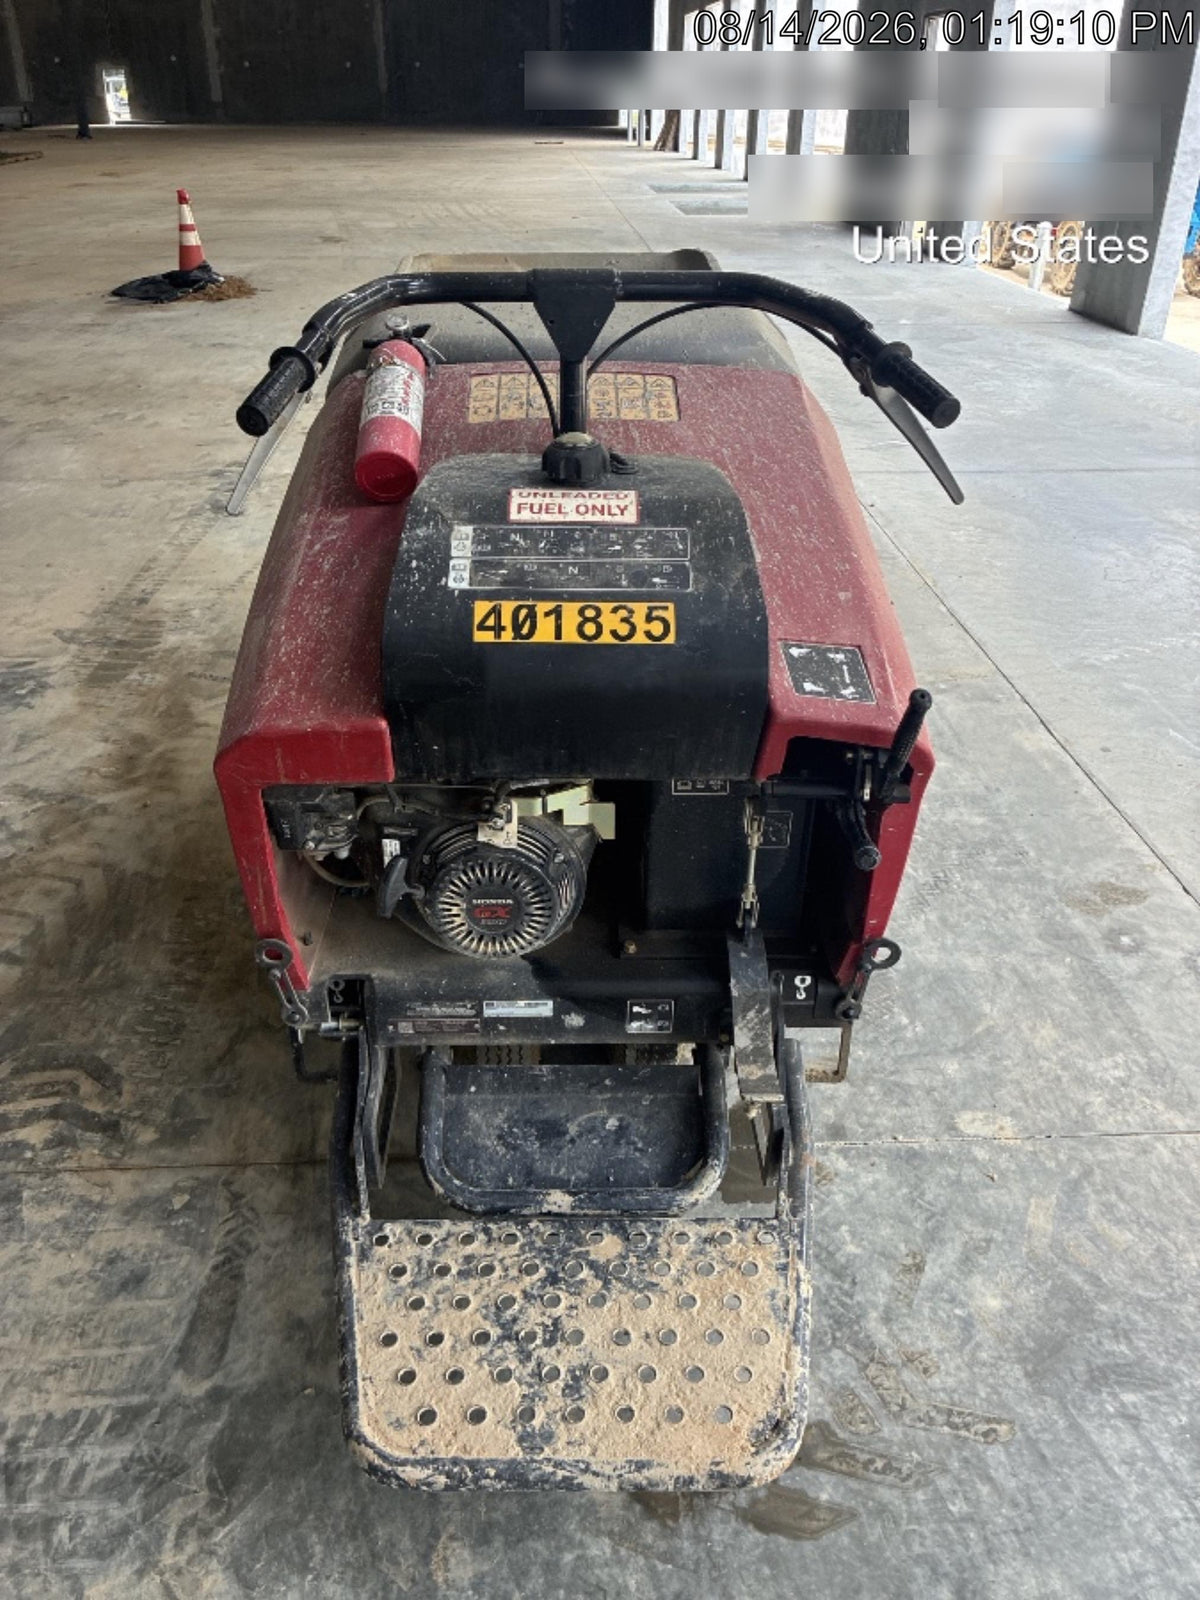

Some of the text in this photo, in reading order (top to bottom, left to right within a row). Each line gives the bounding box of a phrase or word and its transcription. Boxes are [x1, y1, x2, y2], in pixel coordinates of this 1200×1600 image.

[518, 491, 629, 500] UNLEADED
[516, 502, 628, 517] FUEL ONLY
[475, 603, 671, 642] 401835
